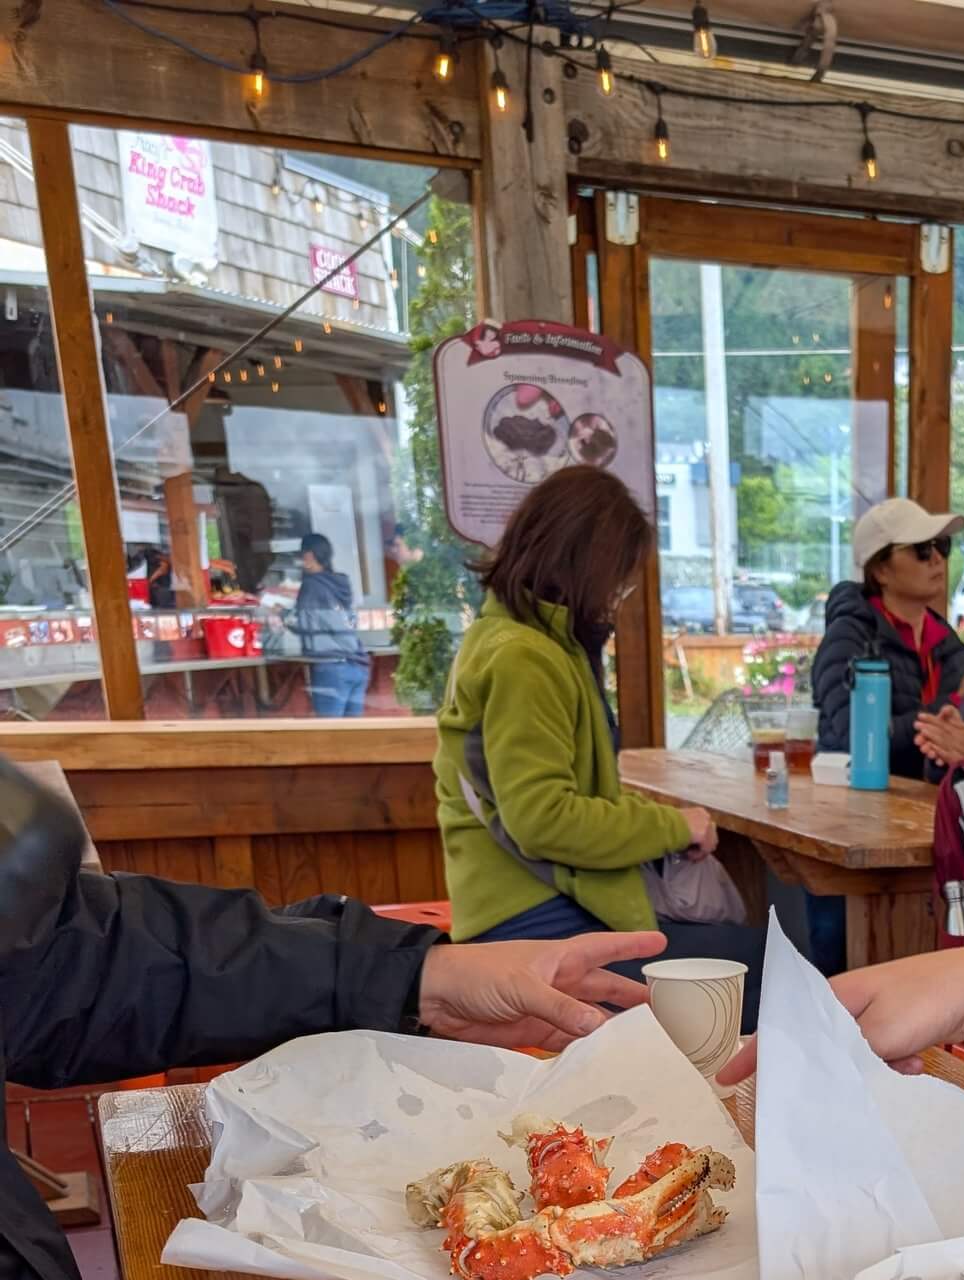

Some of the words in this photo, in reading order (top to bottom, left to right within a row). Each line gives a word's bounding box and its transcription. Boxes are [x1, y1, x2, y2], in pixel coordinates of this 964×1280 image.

[129, 150, 166, 190] King
[170, 166, 205, 196] Crab
[145, 184, 196, 217] Shack
[545, 334, 603, 355] Information
